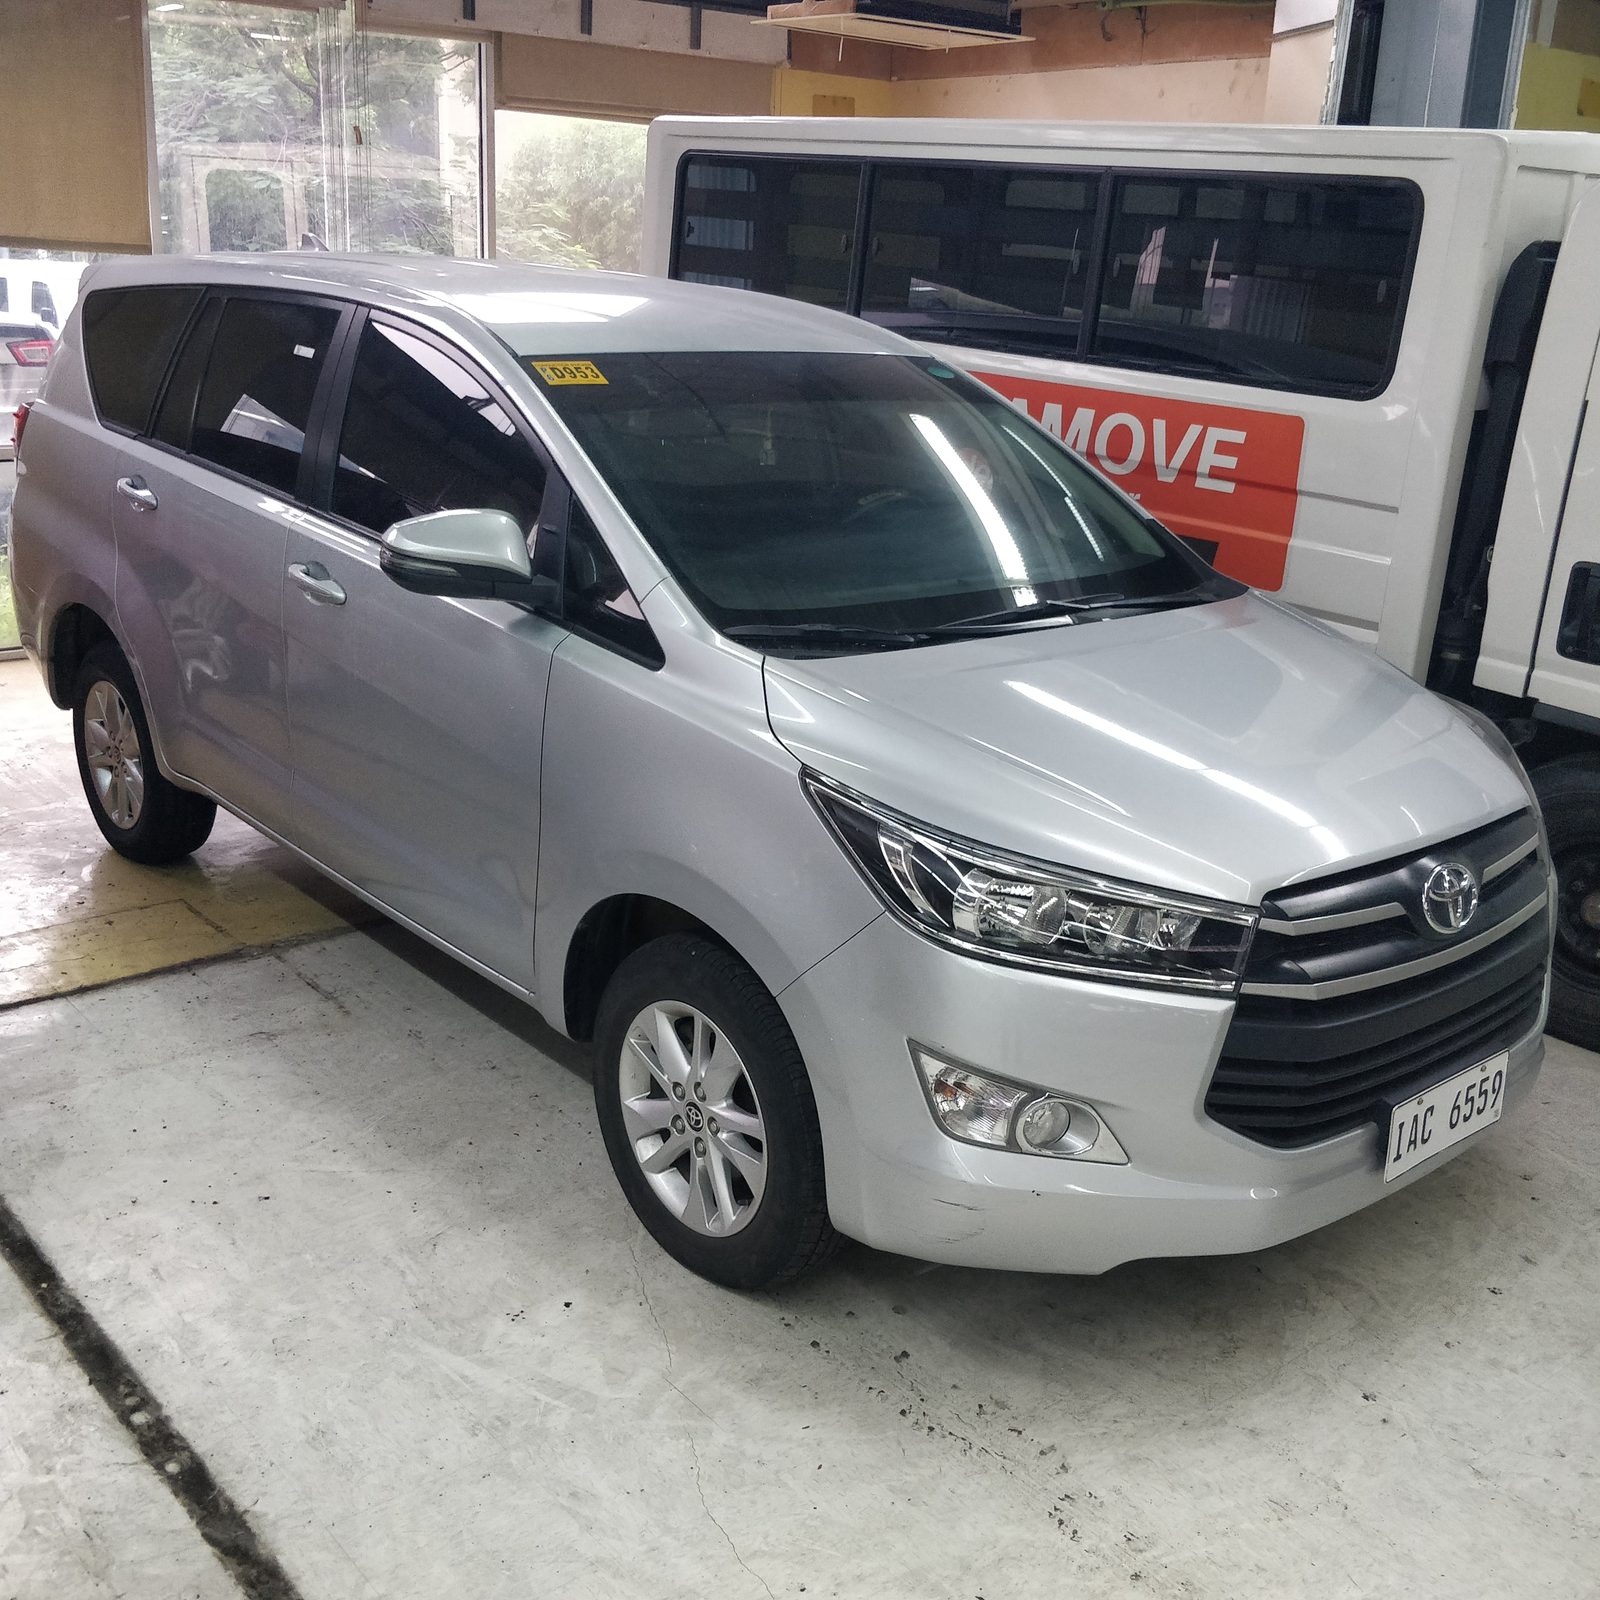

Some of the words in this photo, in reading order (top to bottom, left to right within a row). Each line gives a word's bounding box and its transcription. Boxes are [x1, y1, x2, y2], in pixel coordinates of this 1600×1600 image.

[549, 366, 600, 379] D953
[1011, 397, 1247, 493] MOVE
[1393, 1105, 1435, 1163] IAC
[1449, 1070, 1503, 1129] 6559
